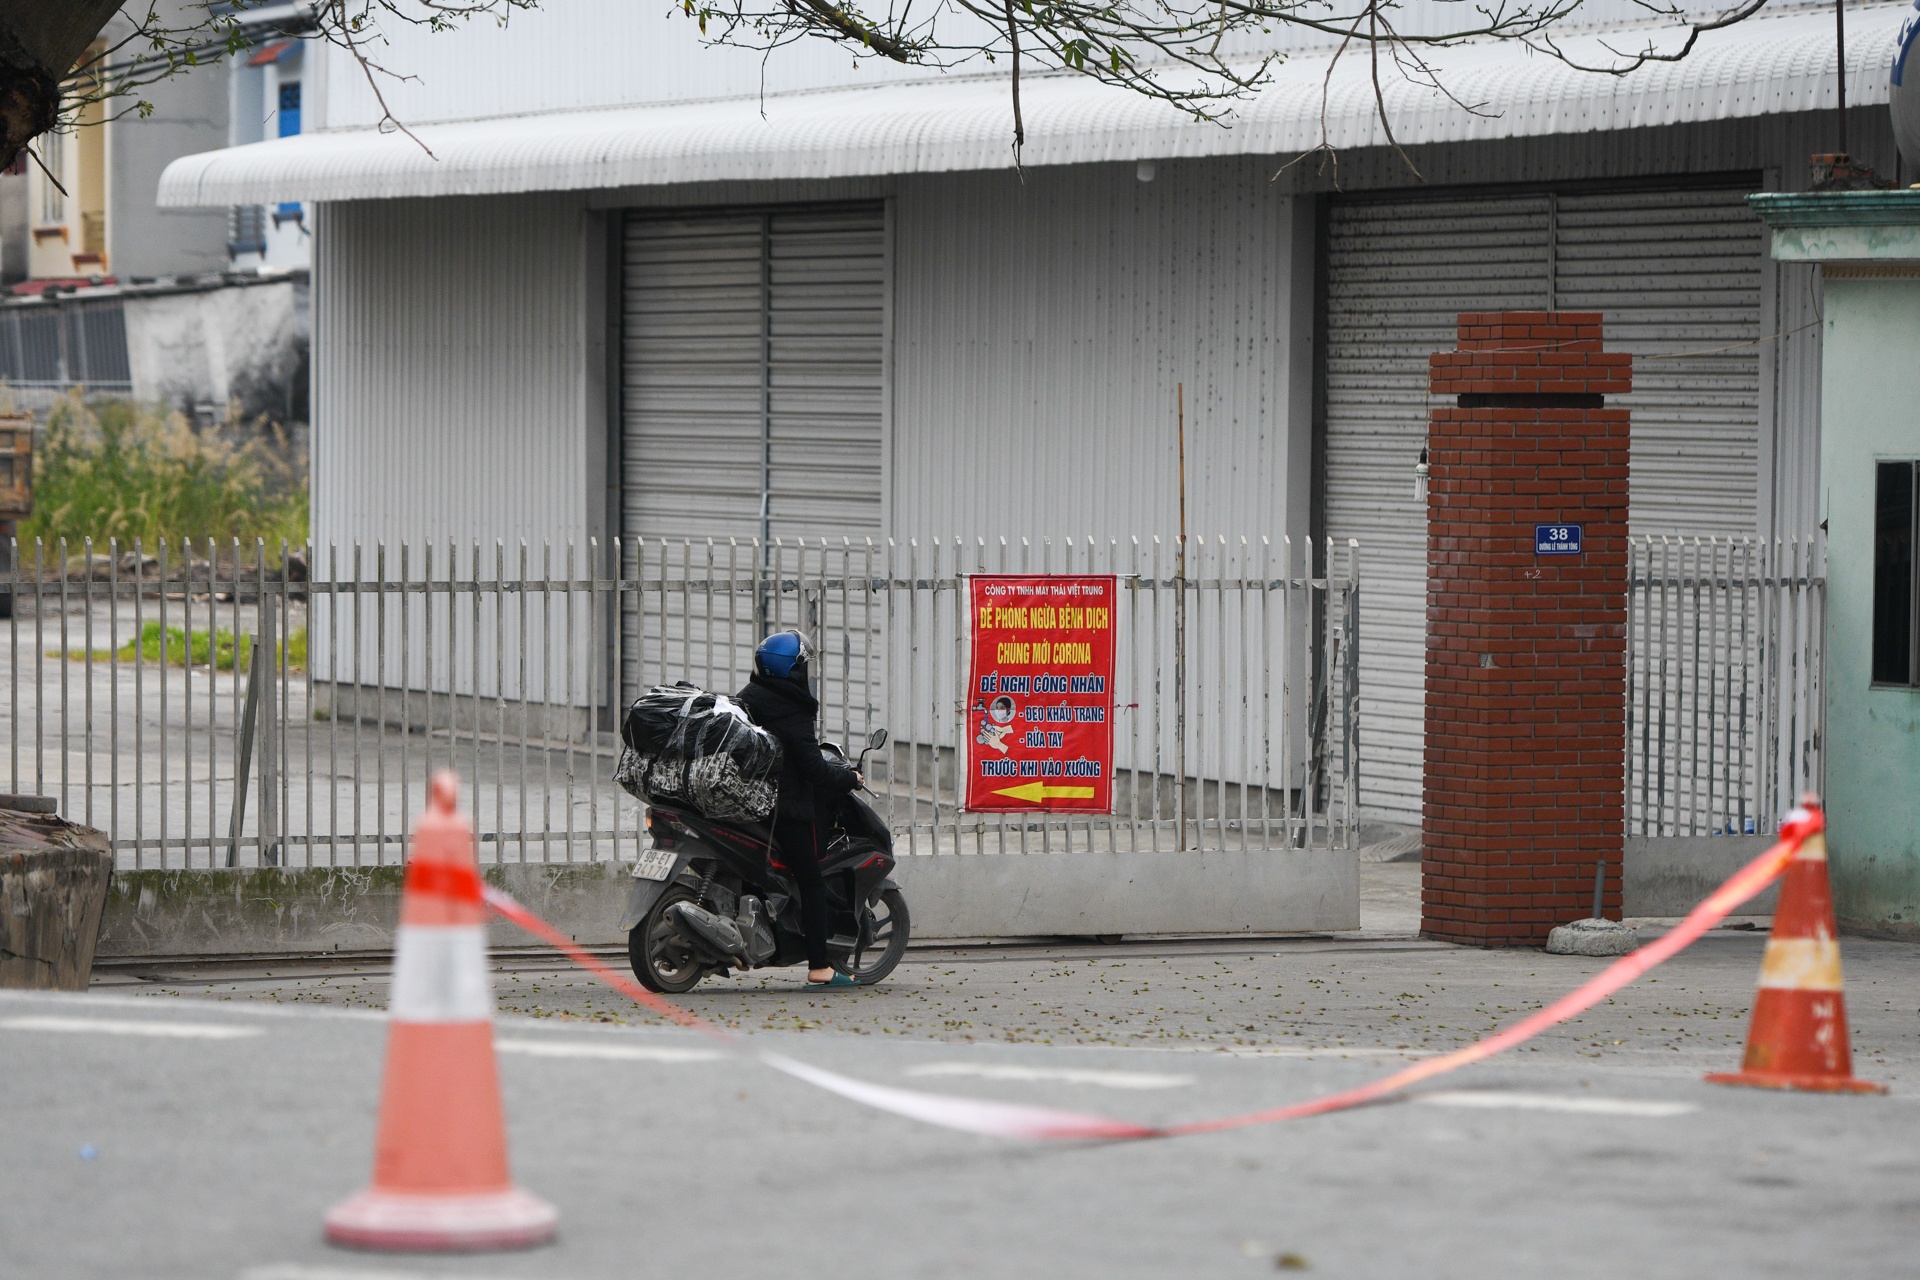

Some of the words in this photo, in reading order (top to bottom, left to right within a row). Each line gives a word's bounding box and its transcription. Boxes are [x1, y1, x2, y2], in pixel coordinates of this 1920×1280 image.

[1549, 528, 1568, 540] 38
[985, 584, 1006, 595] CÔNG
[1008, 586, 1015, 595] TY
[1017, 586, 1034, 595] TNHH
[1035, 586, 1049, 595] MAY
[1050, 583, 1065, 595] THÁI
[1067, 583, 1080, 598] VIỆT
[1082, 586, 1103, 595] TRUNG
[995, 602, 1028, 629] PHÒNG
[1030, 603, 1056, 629] NGỪA
[1059, 603, 1083, 634] BỆNH
[1086, 607, 1108, 634] DỊCH
[997, 635, 1030, 664] CHỦNG
[1032, 638, 1050, 664] MỚI
[1053, 642, 1091, 664] CORONA
[1000, 675, 1031, 697] NGHỊ
[1033, 672, 1067, 693] CÔNG
[1070, 672, 1105, 693] NHÂN
[1025, 706, 1044, 722] ĐEO
[1046, 700, 1072, 722] KHẨU
[1074, 706, 1104, 722] TRANG
[1026, 727, 1046, 747] RỬA
[1047, 732, 1063, 748] TAY
[981, 758, 1017, 776] TRƯỚC
[1019, 760, 1038, 776] KHI
[1041, 757, 1062, 777] VÀO
[1064, 756, 1101, 777] XƯỞNG
[643, 851, 671, 865] 99-E1
